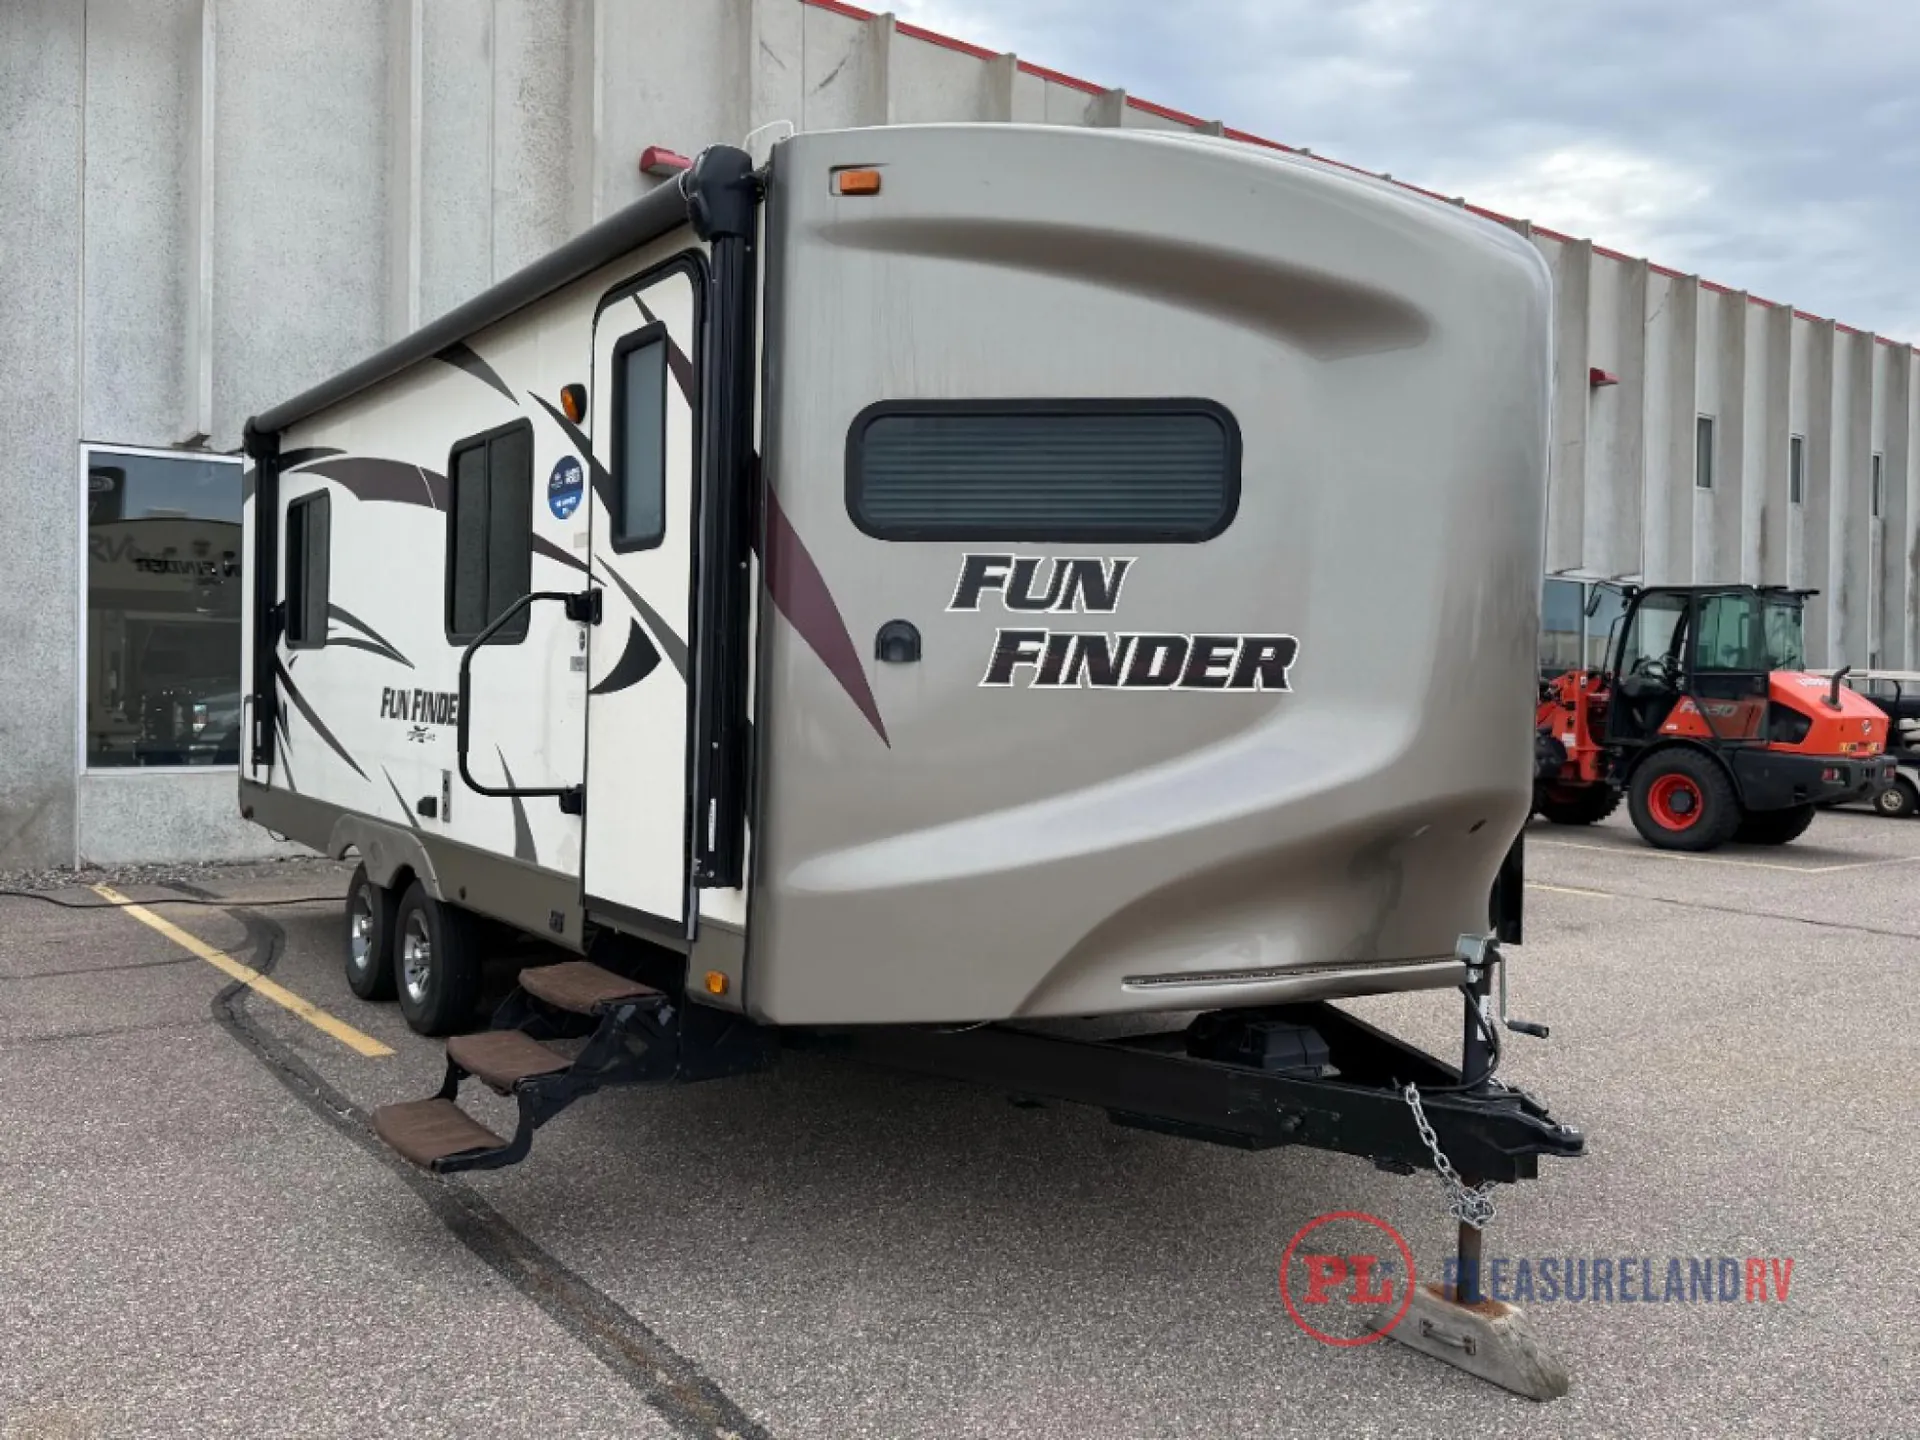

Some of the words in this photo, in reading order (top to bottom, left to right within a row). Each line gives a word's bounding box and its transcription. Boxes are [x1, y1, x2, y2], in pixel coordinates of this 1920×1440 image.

[945, 553, 1138, 613] FUN
[977, 628, 1300, 692] FINDER
[380, 687, 411, 720] FUN
[411, 687, 459, 727] FINDE
